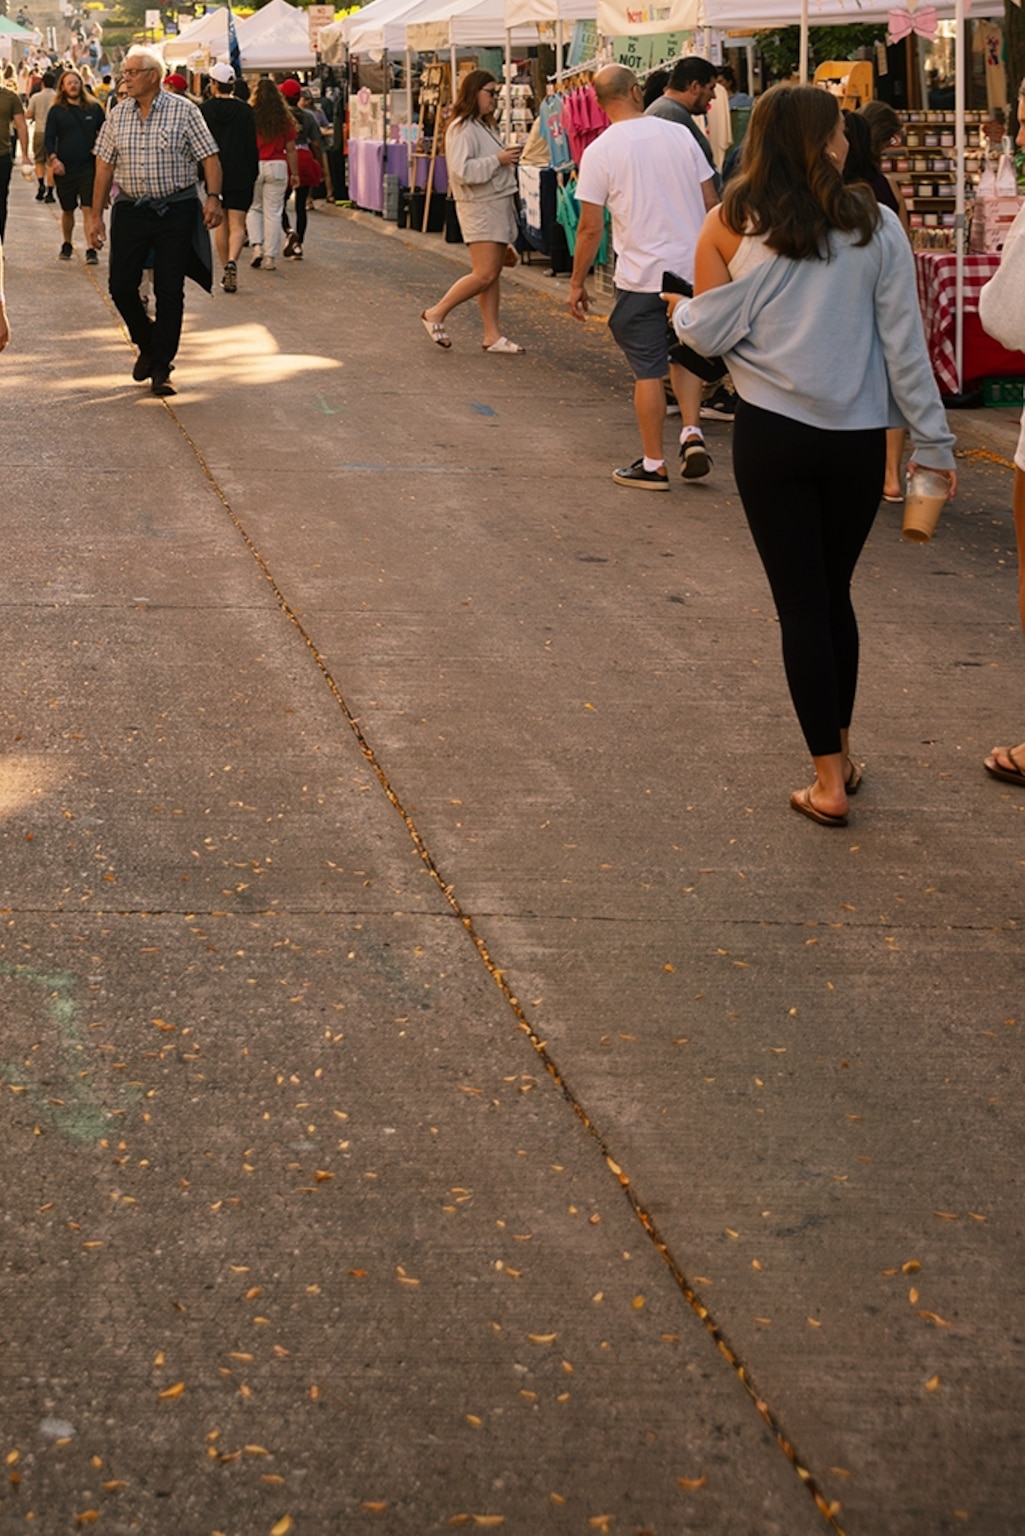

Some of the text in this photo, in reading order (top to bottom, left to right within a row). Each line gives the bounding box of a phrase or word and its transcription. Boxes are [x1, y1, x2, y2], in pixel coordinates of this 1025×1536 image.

[628, 44, 636, 53] IS
[668, 47, 676, 57] IS
[619, 54, 642, 68] NOT
